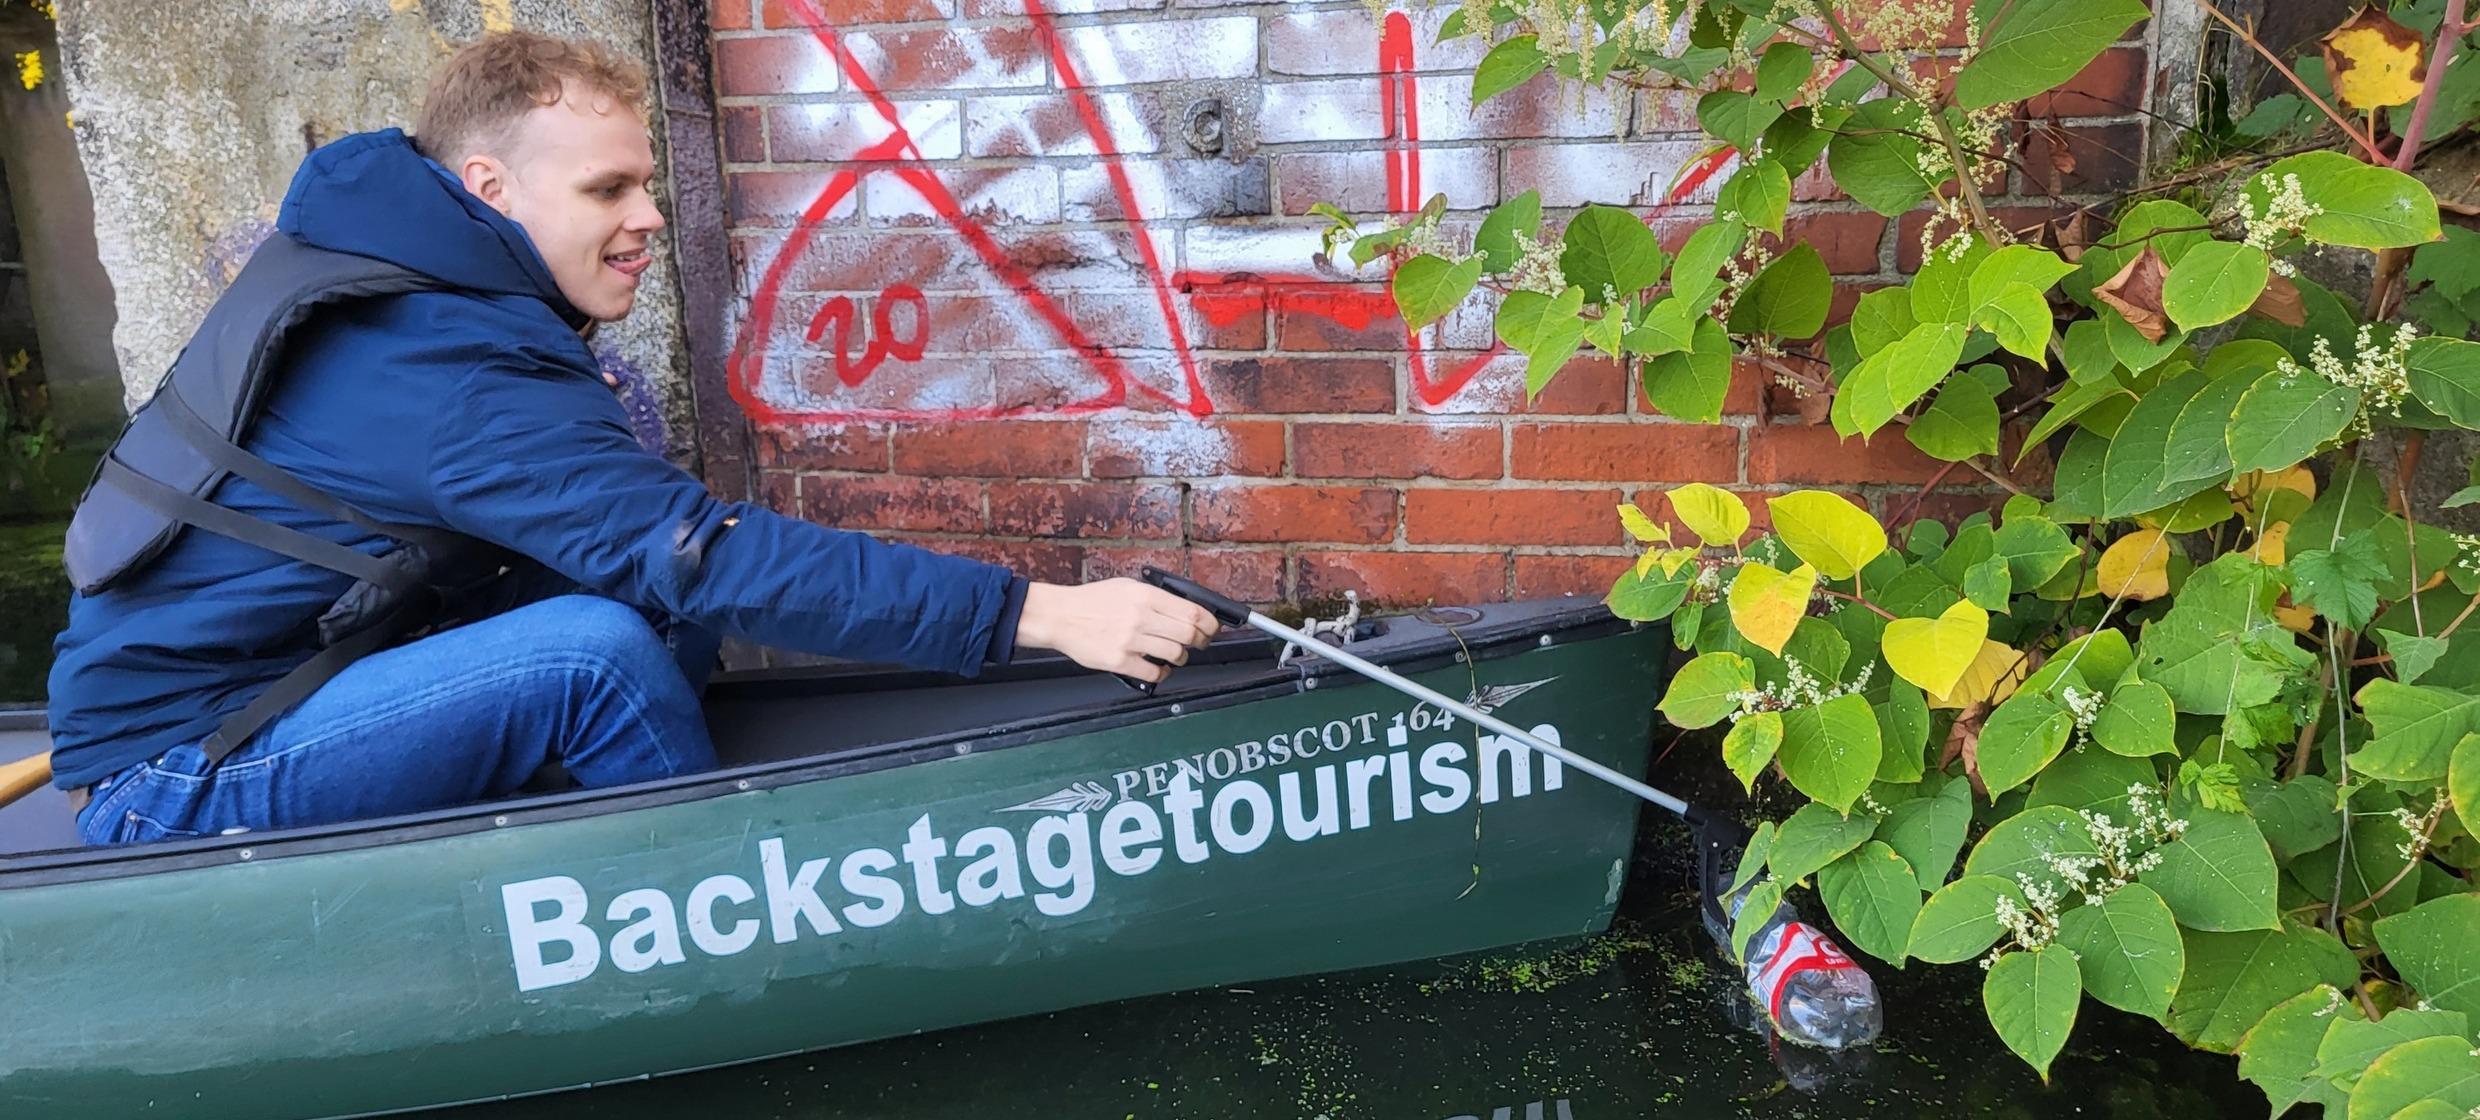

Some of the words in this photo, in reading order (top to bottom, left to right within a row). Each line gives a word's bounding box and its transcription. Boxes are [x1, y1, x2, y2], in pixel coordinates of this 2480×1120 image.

[1112, 712, 1379, 804] PENOBSCOT
[1389, 699, 1456, 734] 164
[501, 723, 1562, 992] Backstagetourism
